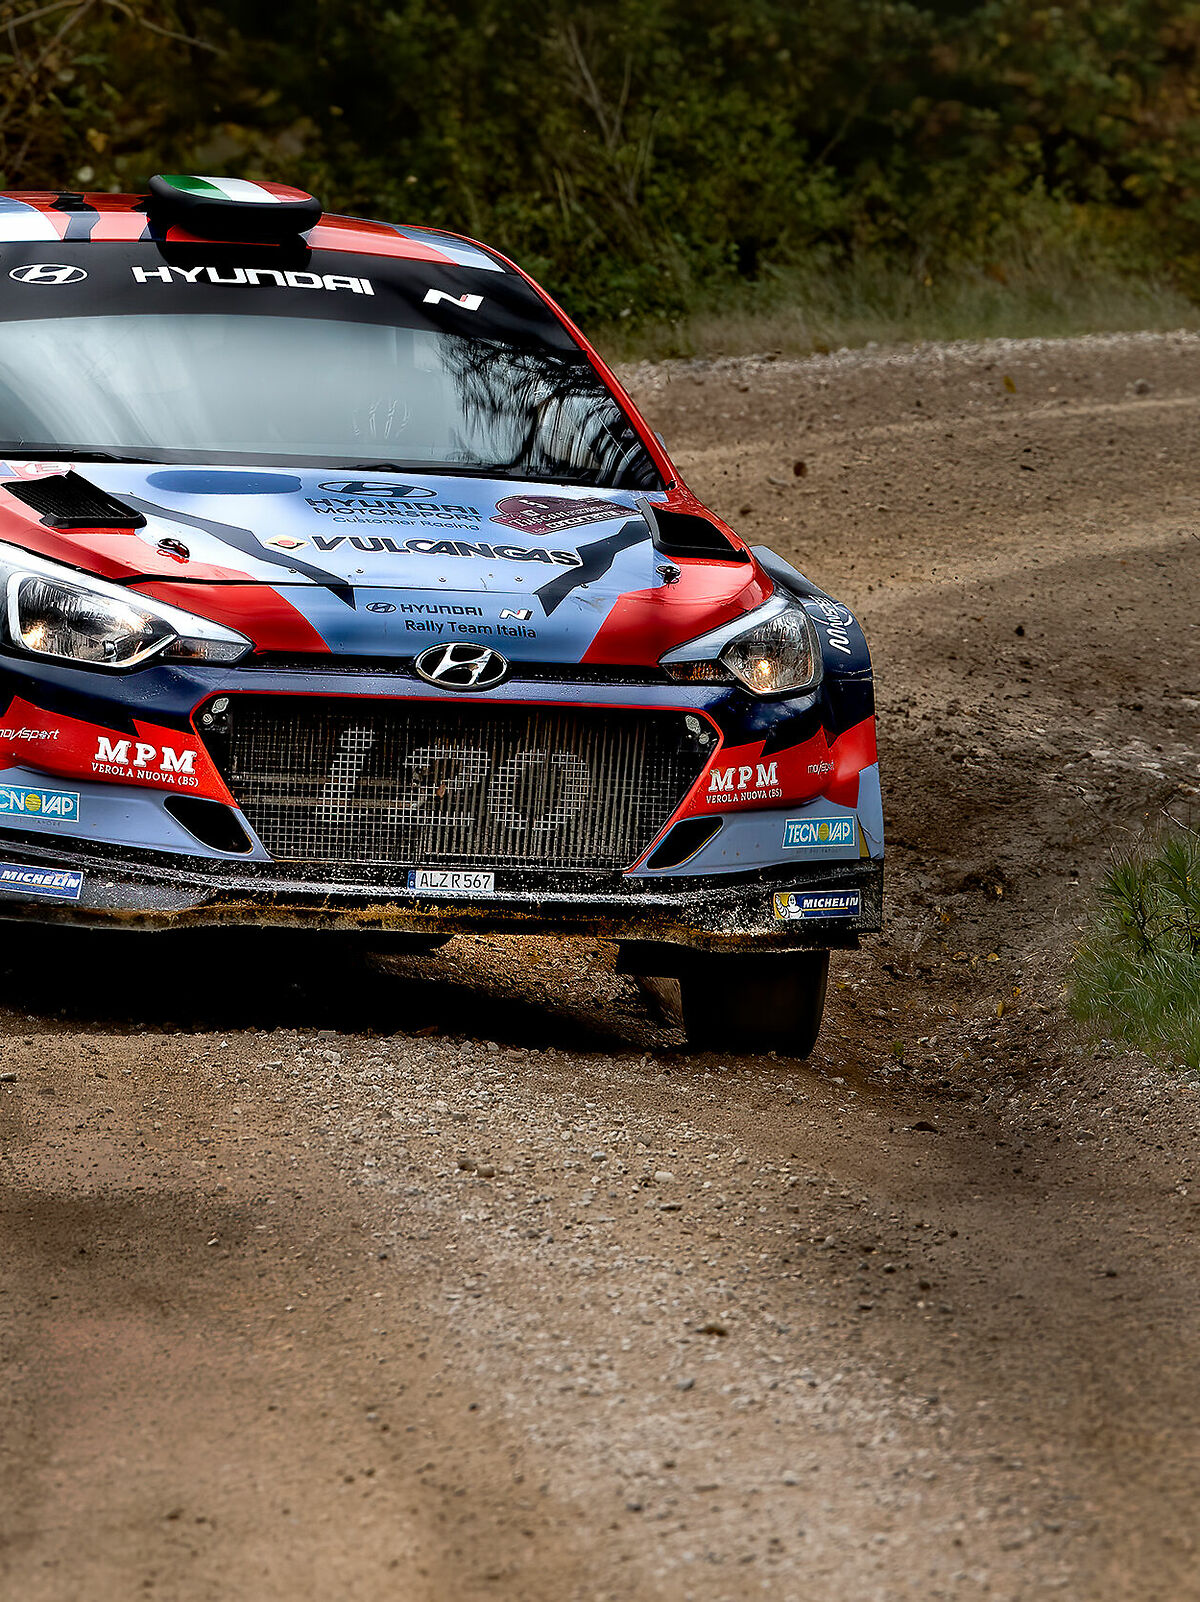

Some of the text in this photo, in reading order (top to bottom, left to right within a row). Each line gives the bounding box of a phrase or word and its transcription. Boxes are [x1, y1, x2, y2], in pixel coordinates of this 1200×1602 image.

[132, 266, 375, 296] HYUNDAI
[305, 498, 480, 515] HYUNDAI
[313, 507, 483, 523] MOTORSPORT
[332, 516, 481, 532] Customer Racing
[312, 536, 581, 566] VULCANGAS
[401, 603, 484, 617] HYUNDAI
[405, 619, 537, 639] Rally Team Italia
[94, 736, 198, 775] MPM
[91, 762, 200, 788] VEROLA NUOVA (BS)
[708, 762, 779, 792] MPM
[706, 787, 783, 804] VEROLA NUOVA (BS)
[0, 869, 81, 889] MICHELIN
[803, 896, 859, 909] MICHELIN
